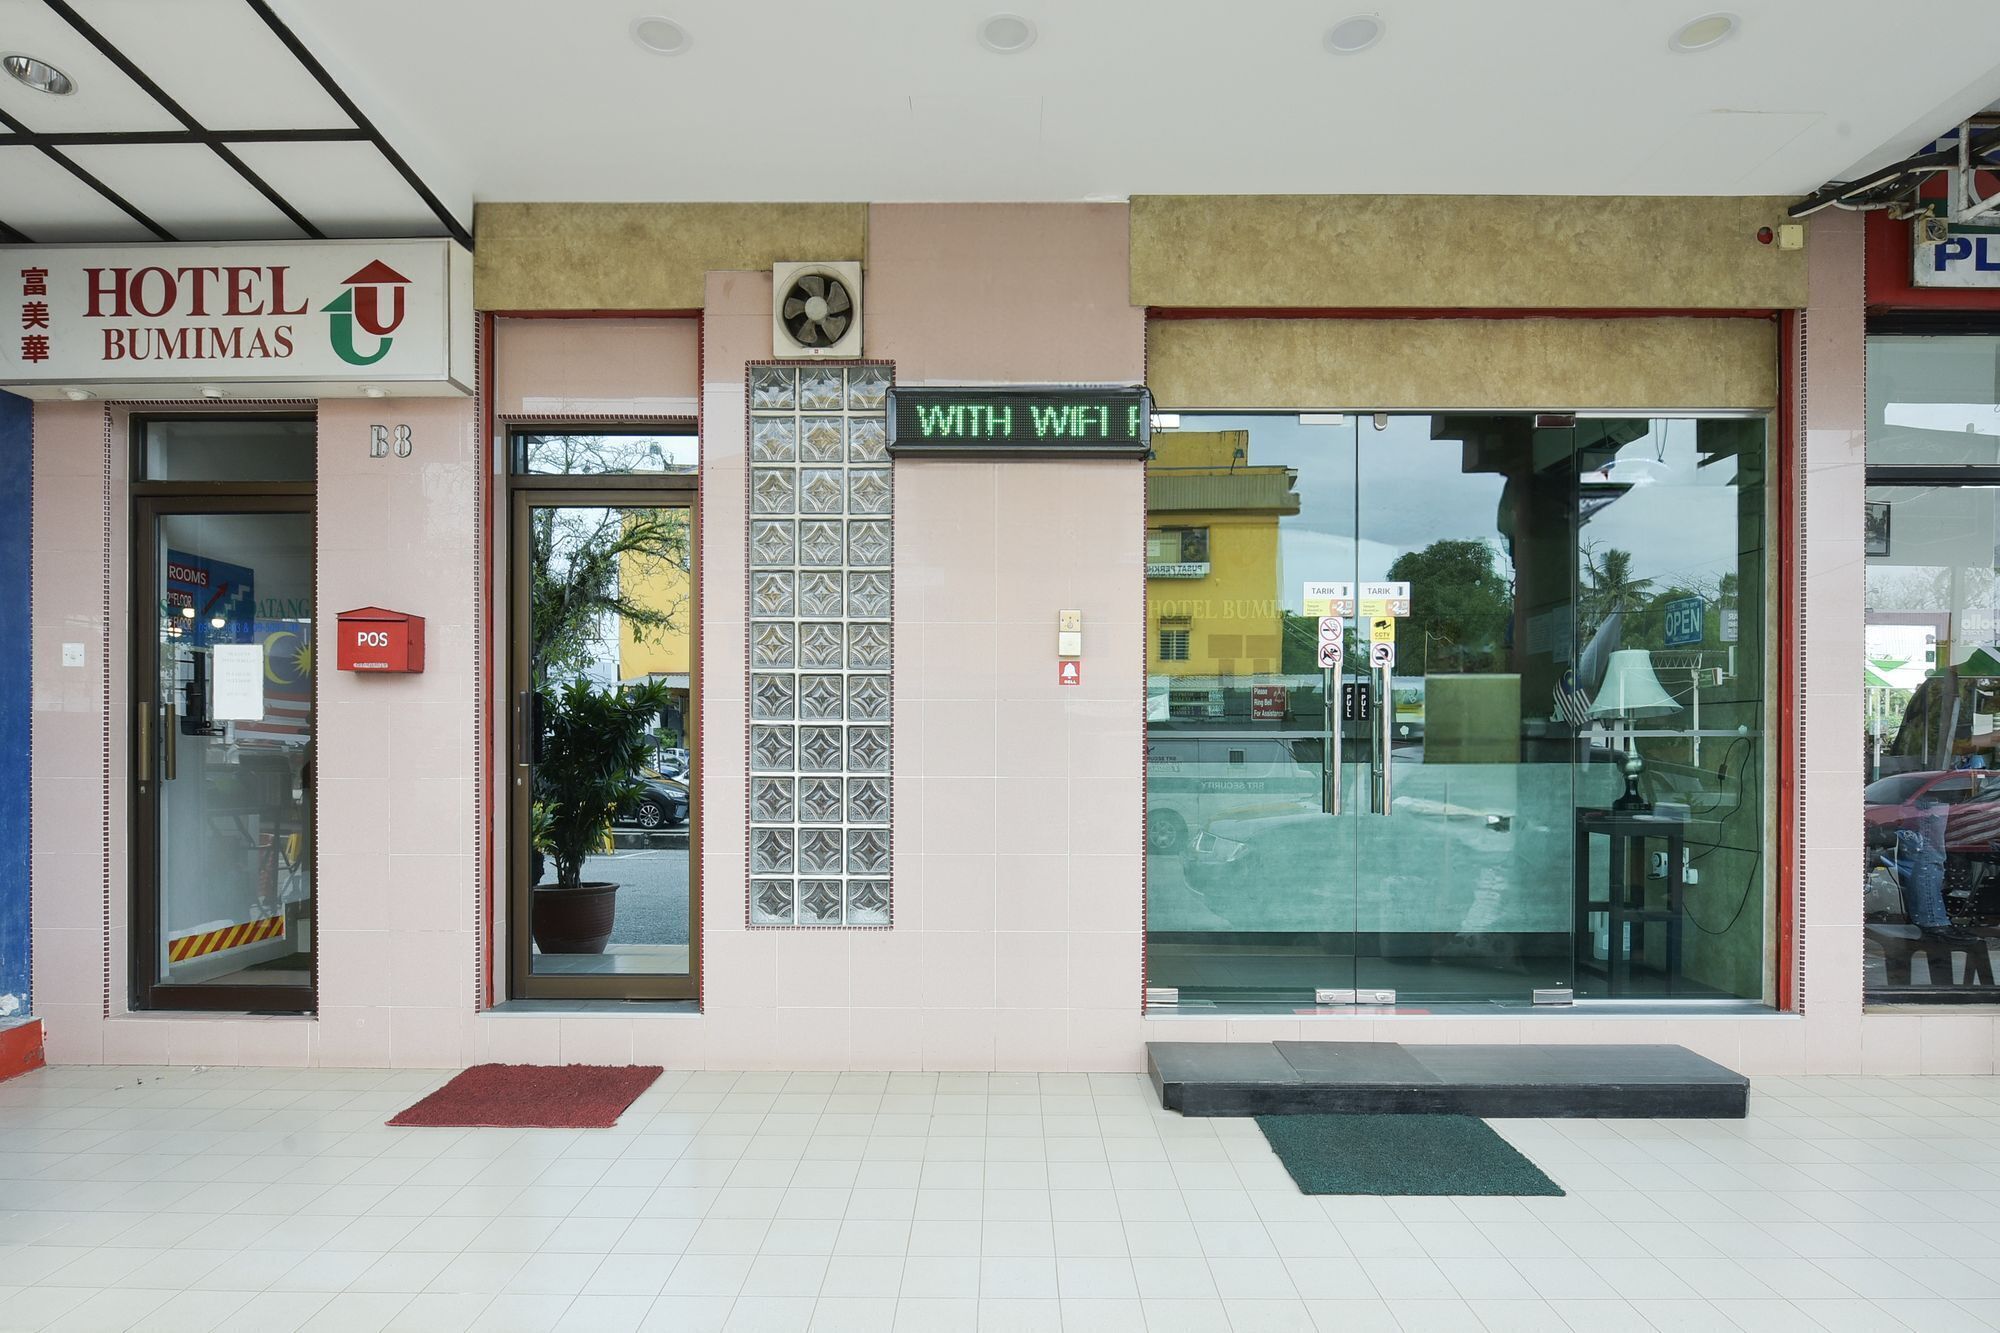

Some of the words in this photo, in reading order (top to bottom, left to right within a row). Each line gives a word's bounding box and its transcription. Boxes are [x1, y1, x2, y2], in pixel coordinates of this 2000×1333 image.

[82, 265, 310, 318] HOTEL
[20, 266, 50, 364] 富美華
[101, 325, 294, 361] BUMIMAS
[916, 405, 1011, 437] WITH
[1030, 405, 1108, 437] WIFI
[168, 565, 207, 585] ROOMS
[1311, 587, 1335, 595] TARIK
[1367, 587, 1391, 595] TARIK
[1665, 608, 1700, 637] OPEN
[357, 631, 388, 647] POS
